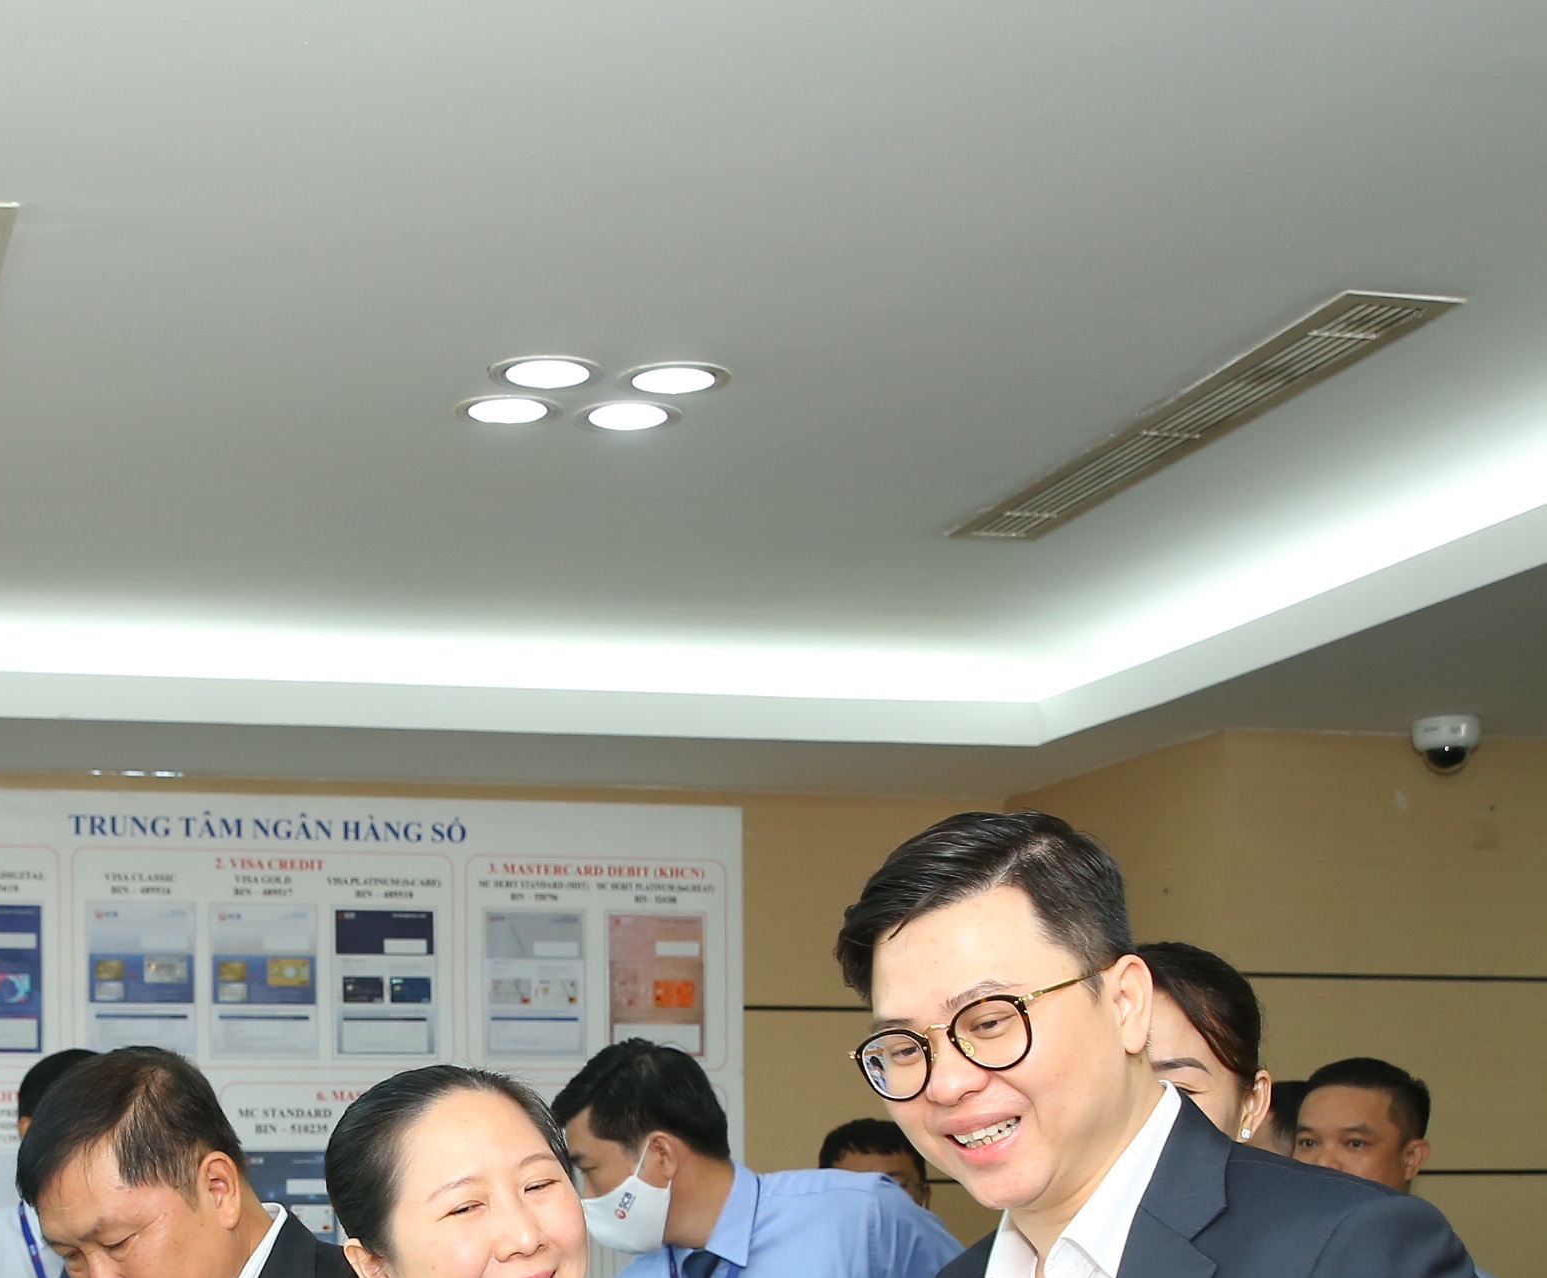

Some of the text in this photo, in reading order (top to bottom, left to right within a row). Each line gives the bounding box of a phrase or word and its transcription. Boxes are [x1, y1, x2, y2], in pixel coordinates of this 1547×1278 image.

[68, 814, 171, 838] TRUNG
[178, 810, 243, 839] TÂM
[253, 813, 333, 841] NGÂN
[342, 814, 422, 843] HÀNG
[215, 857, 325, 872] 2. VISA CREDIT
[503, 863, 604, 878] MASTERCARD
[607, 866, 649, 879] DEBIT
[653, 866, 705, 880] (KHCN)
[239, 1107, 333, 1119] MC STANDARD
[255, 1123, 277, 1134] BIN
[290, 1123, 328, 1135] 510235
[618, 1191, 633, 1210] SCB
